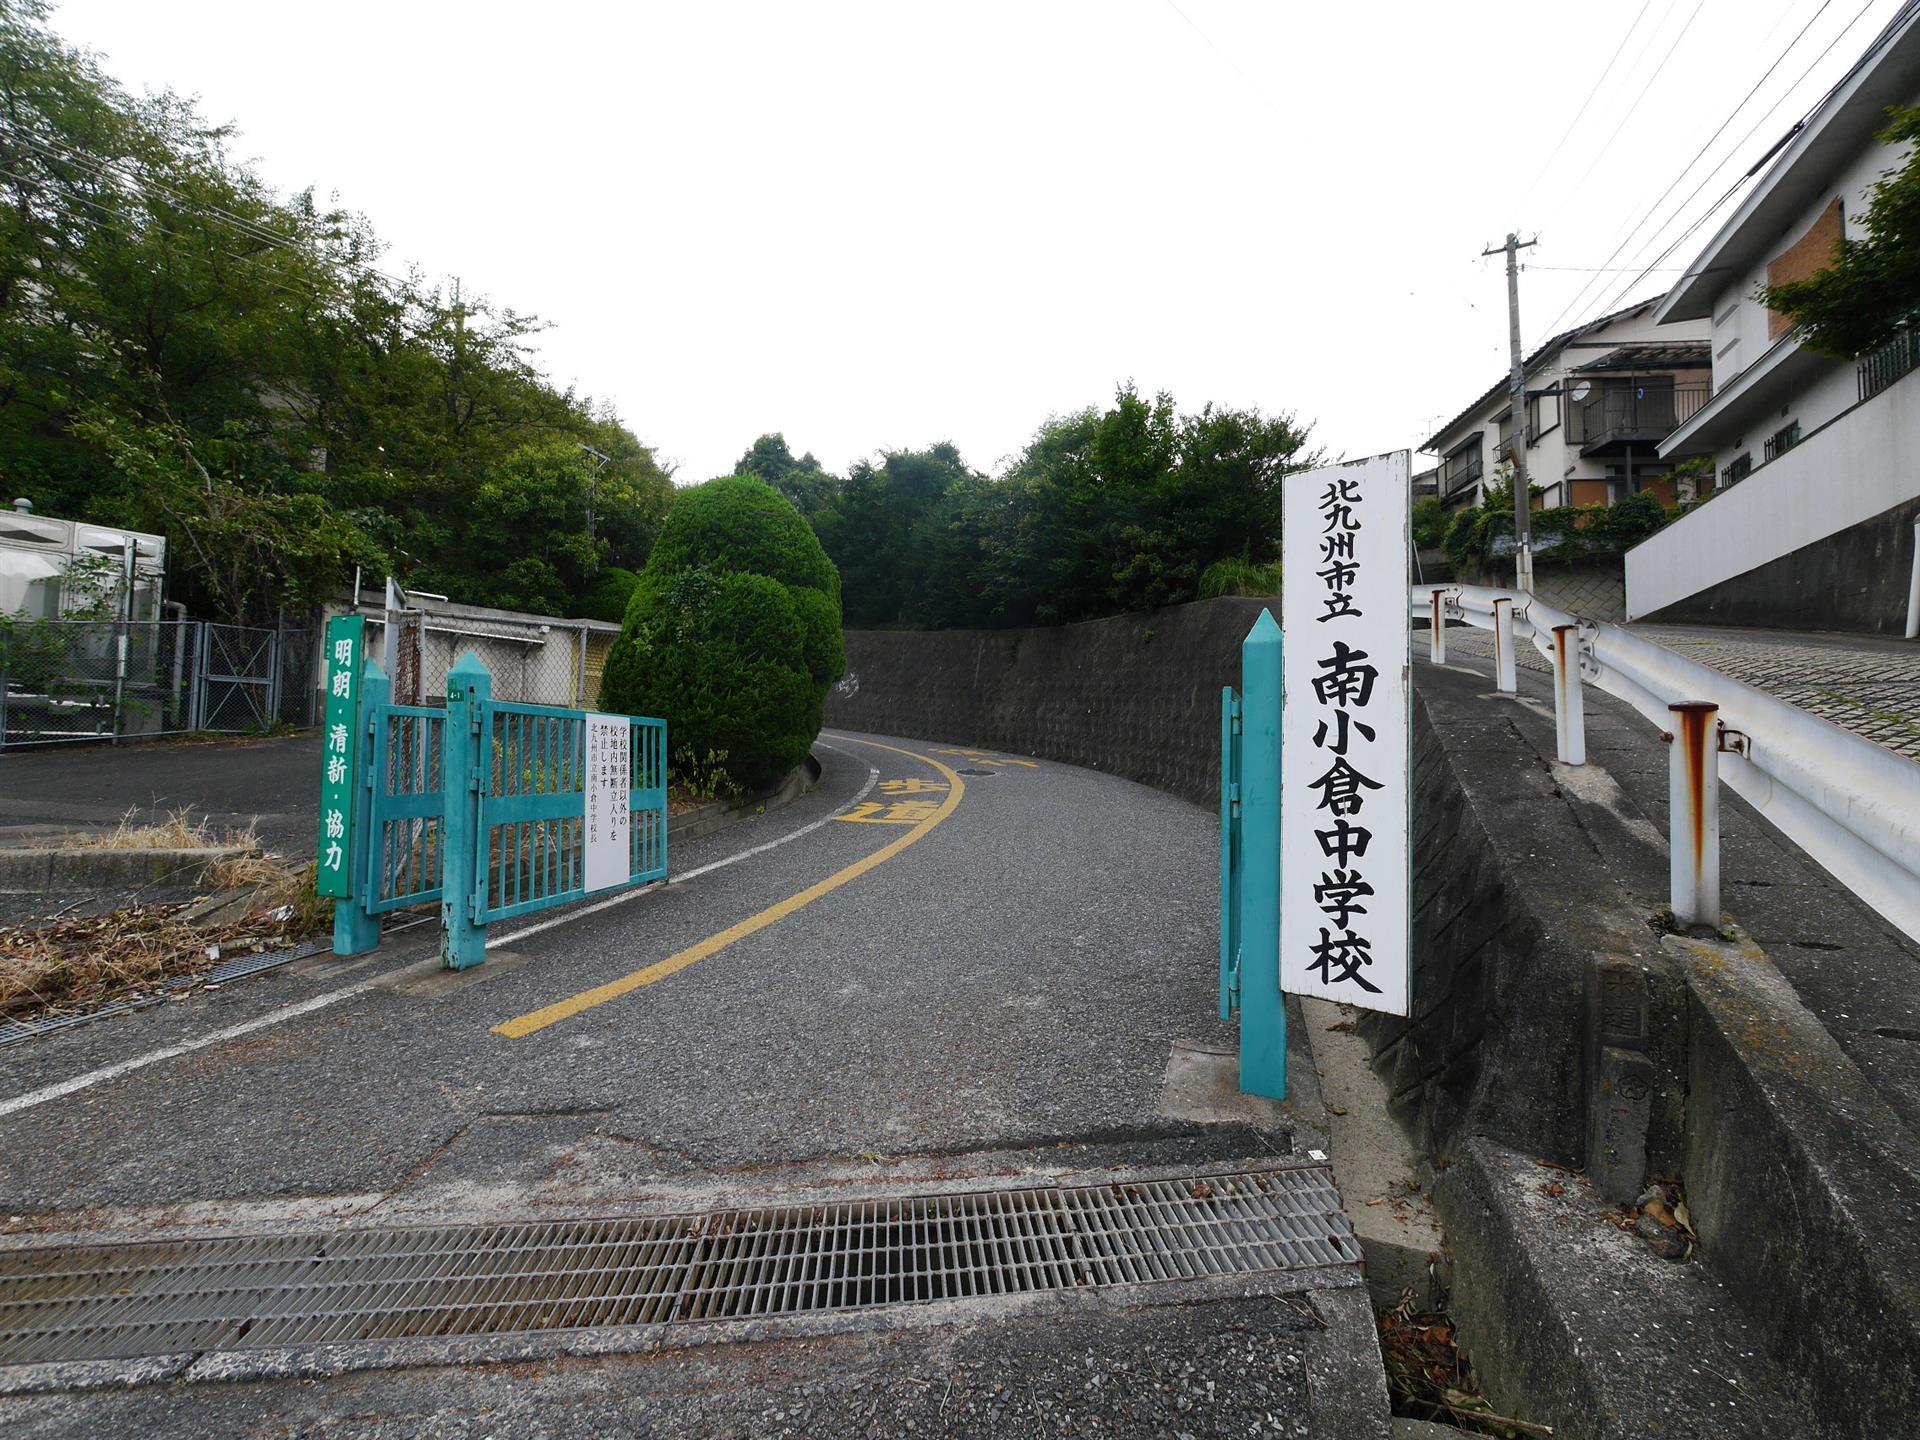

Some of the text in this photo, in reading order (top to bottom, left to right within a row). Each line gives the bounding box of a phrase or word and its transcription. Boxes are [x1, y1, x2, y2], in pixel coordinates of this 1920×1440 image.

[450, 691, 460, 699] 4-1
[1307, 479, 1386, 995] 北九州市立 南小倉中学校
[590, 723, 598, 843] 北九州市立南小倉中学校長
[600, 724, 609, 790] 禁止します
[609, 724, 618, 841] 校地内無断立入りを
[619, 725, 628, 826] 学校関係者以外の
[831, 778, 950, 825] 歩道
